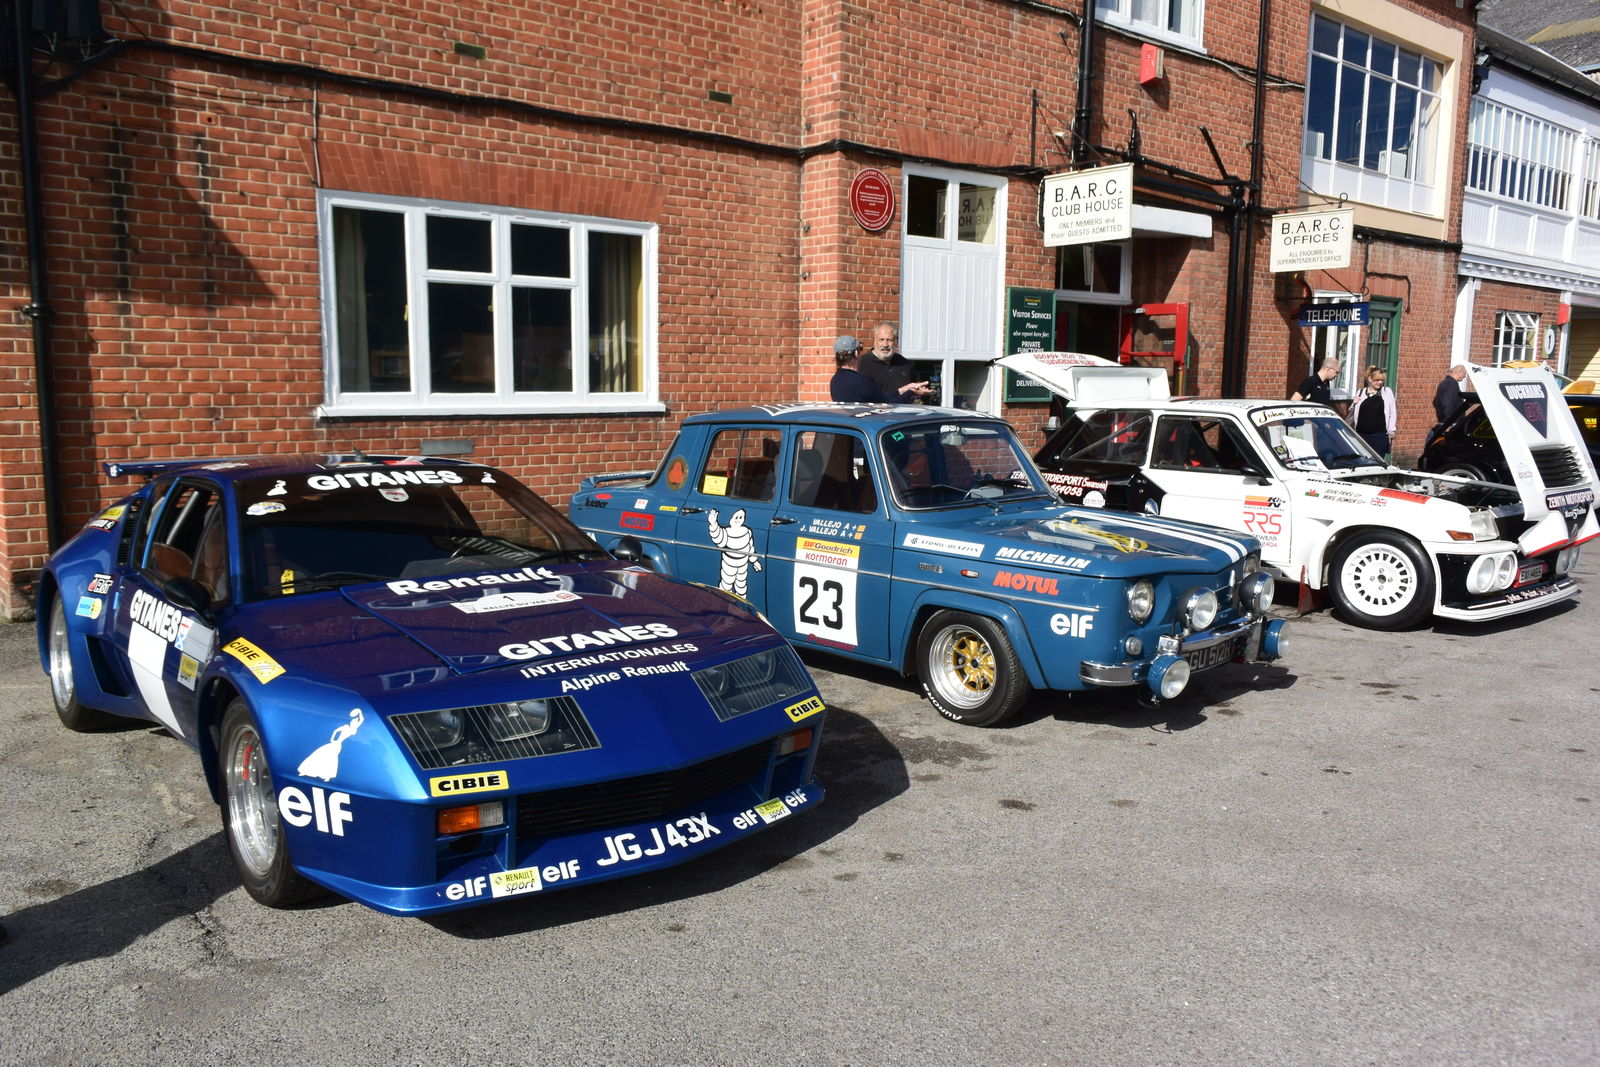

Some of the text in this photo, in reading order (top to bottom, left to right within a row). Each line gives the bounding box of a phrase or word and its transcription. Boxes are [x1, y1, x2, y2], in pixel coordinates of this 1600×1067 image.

[1055, 179, 1122, 202] B.A.R.C.
[1052, 198, 1124, 217] CLUB HOUSE
[1059, 221, 1074, 230] ONLY
[1076, 218, 1102, 228] MEMBERS
[1068, 229, 1090, 238] GUESTS
[1092, 224, 1122, 234] ADMITTED
[1282, 217, 1344, 234] B.A.R.C.
[1284, 232, 1338, 246] OFFICES
[1300, 248, 1327, 257] ENQUIRIES
[1306, 308, 1361, 322] TELEPHONE
[1259, 411, 1284, 424] John
[307, 470, 463, 491] GITANES
[624, 516, 650, 528] MOTUL
[809, 526, 838, 536] VALLEJO
[813, 518, 842, 528] VALLEJO
[1243, 512, 1282, 535] RRS
[803, 540, 853, 554] BFGoodrich
[996, 546, 1091, 569] MICHELIN
[386, 566, 560, 595] Renault
[993, 570, 1060, 596] MOTUL
[799, 576, 843, 630] 23
[130, 589, 182, 642] GITANES
[1050, 613, 1093, 638] elf
[230, 641, 260, 660] CIBIE
[498, 623, 678, 660] GITANES
[520, 643, 699, 678] INTERNATIONALES
[561, 660, 690, 692] Alpine Renault
[790, 699, 820, 717] CIBIE
[438, 775, 500, 791] CIBIE
[785, 788, 808, 807] elf
[278, 786, 353, 837] elf
[733, 809, 758, 830] elf
[770, 806, 786, 820] sport
[506, 870, 533, 881] RENAULT
[542, 859, 580, 882] elf
[446, 876, 487, 900] elf
[506, 878, 535, 894] sport
